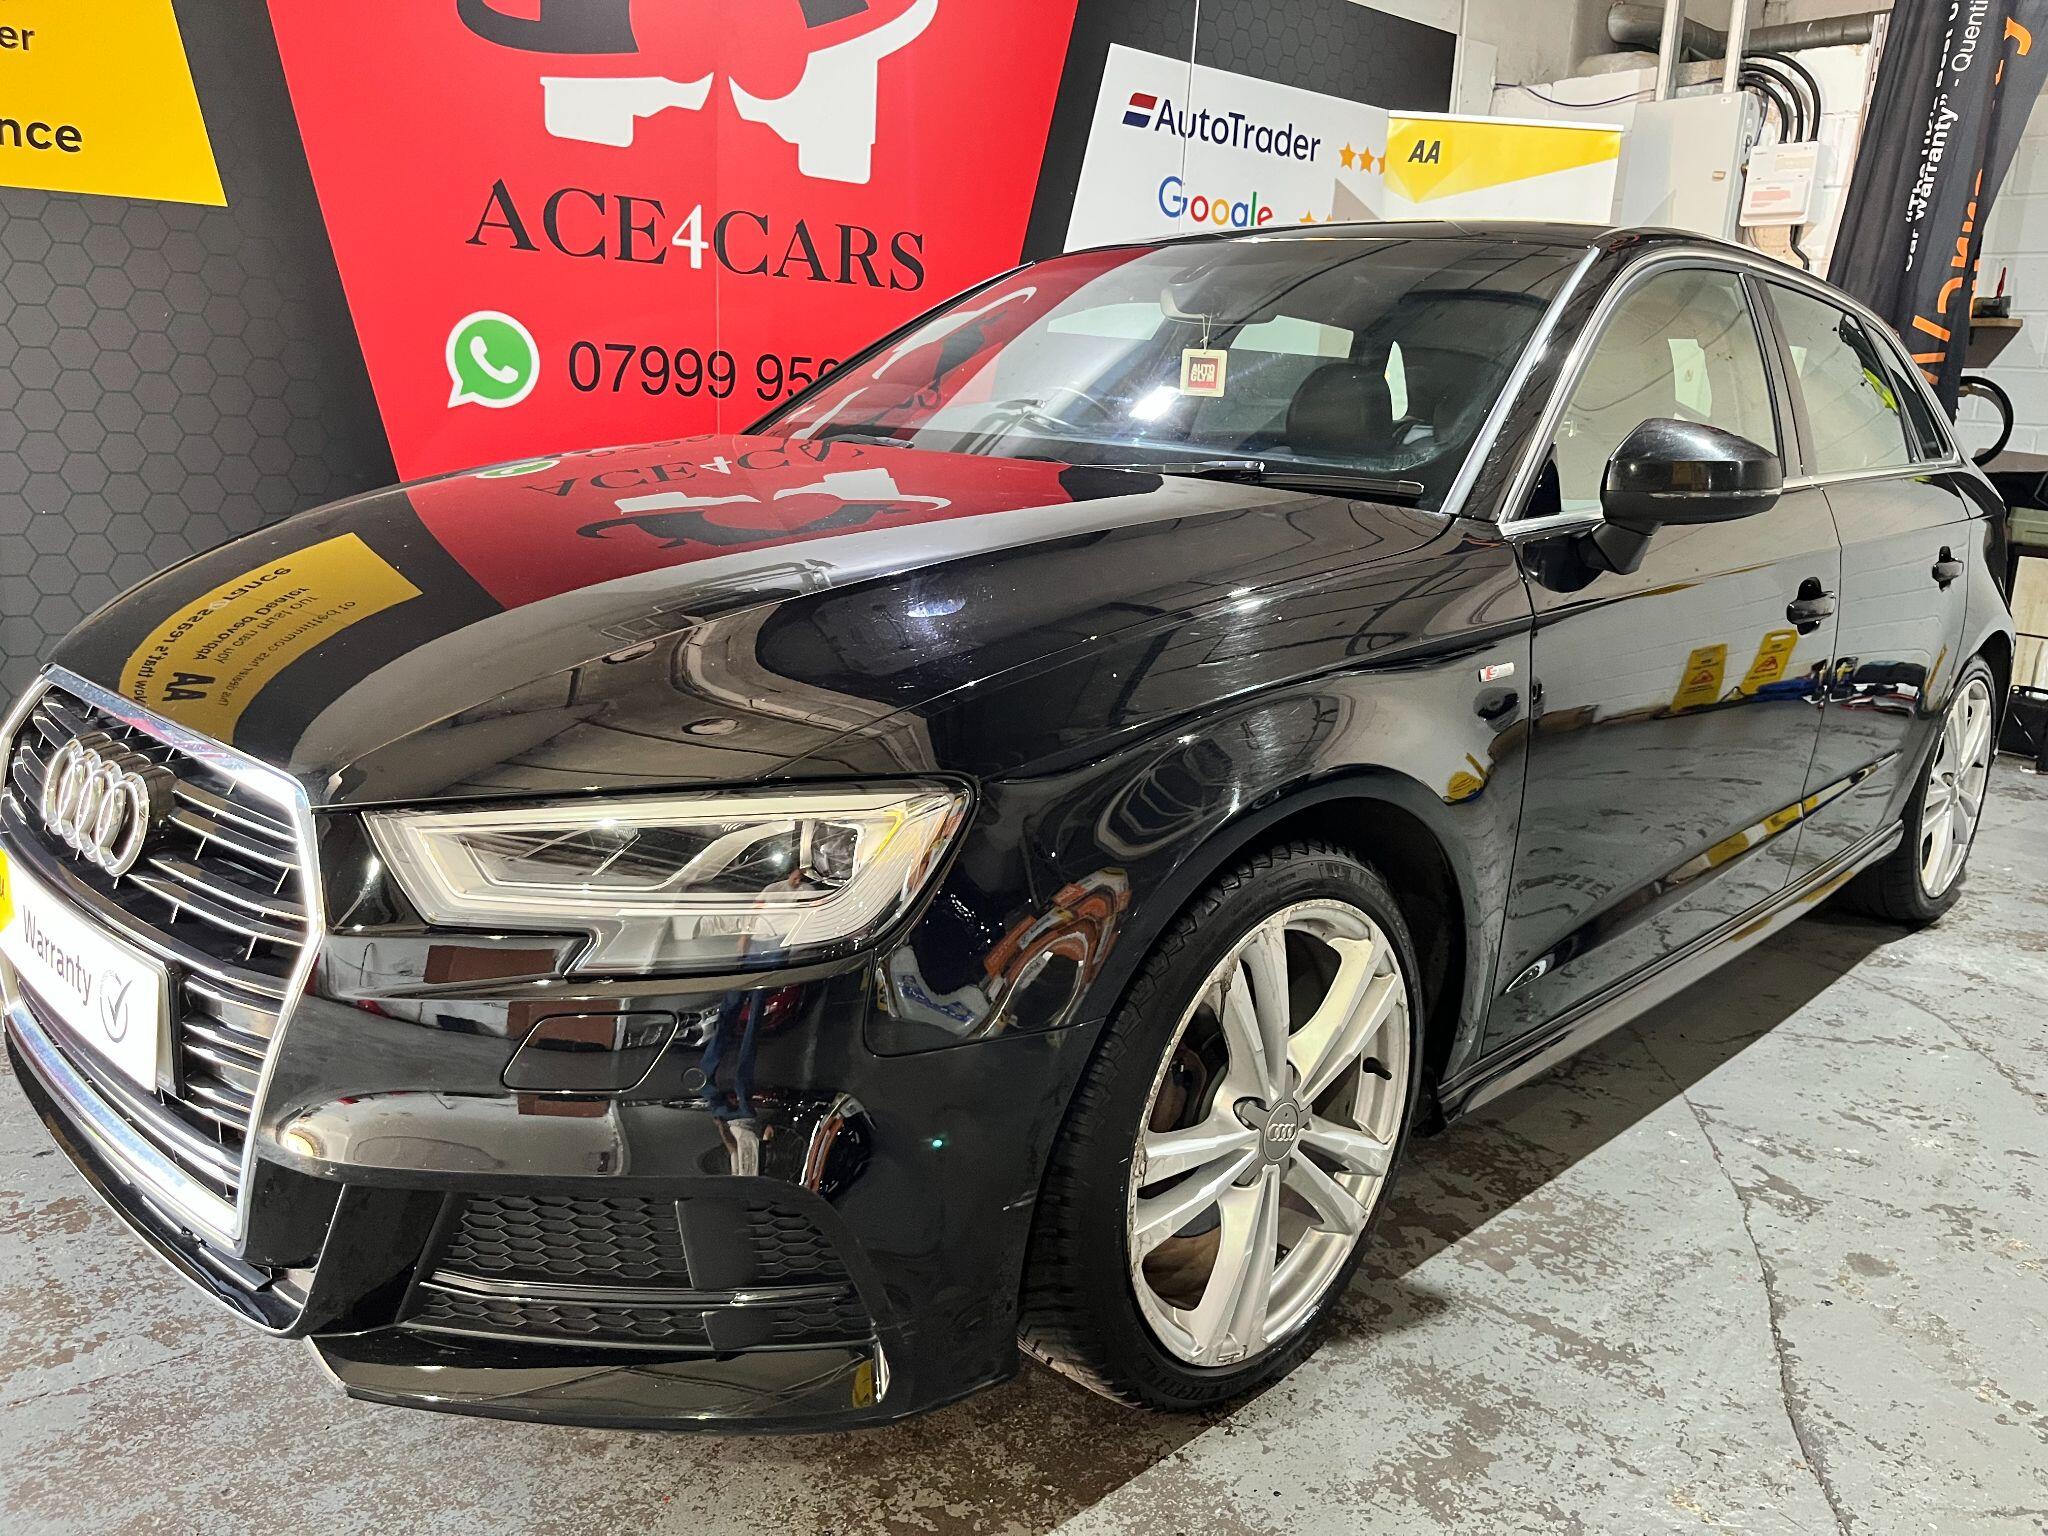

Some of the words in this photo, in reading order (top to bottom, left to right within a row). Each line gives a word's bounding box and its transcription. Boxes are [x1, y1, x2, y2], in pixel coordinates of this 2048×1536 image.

[1154, 99, 1322, 162] AutoTrader
[1407, 139, 1441, 165] AA
[465, 178, 926, 292] ACE4CARS
[568, 341, 736, 398] 07999
[22, 904, 92, 1005] Warranty
